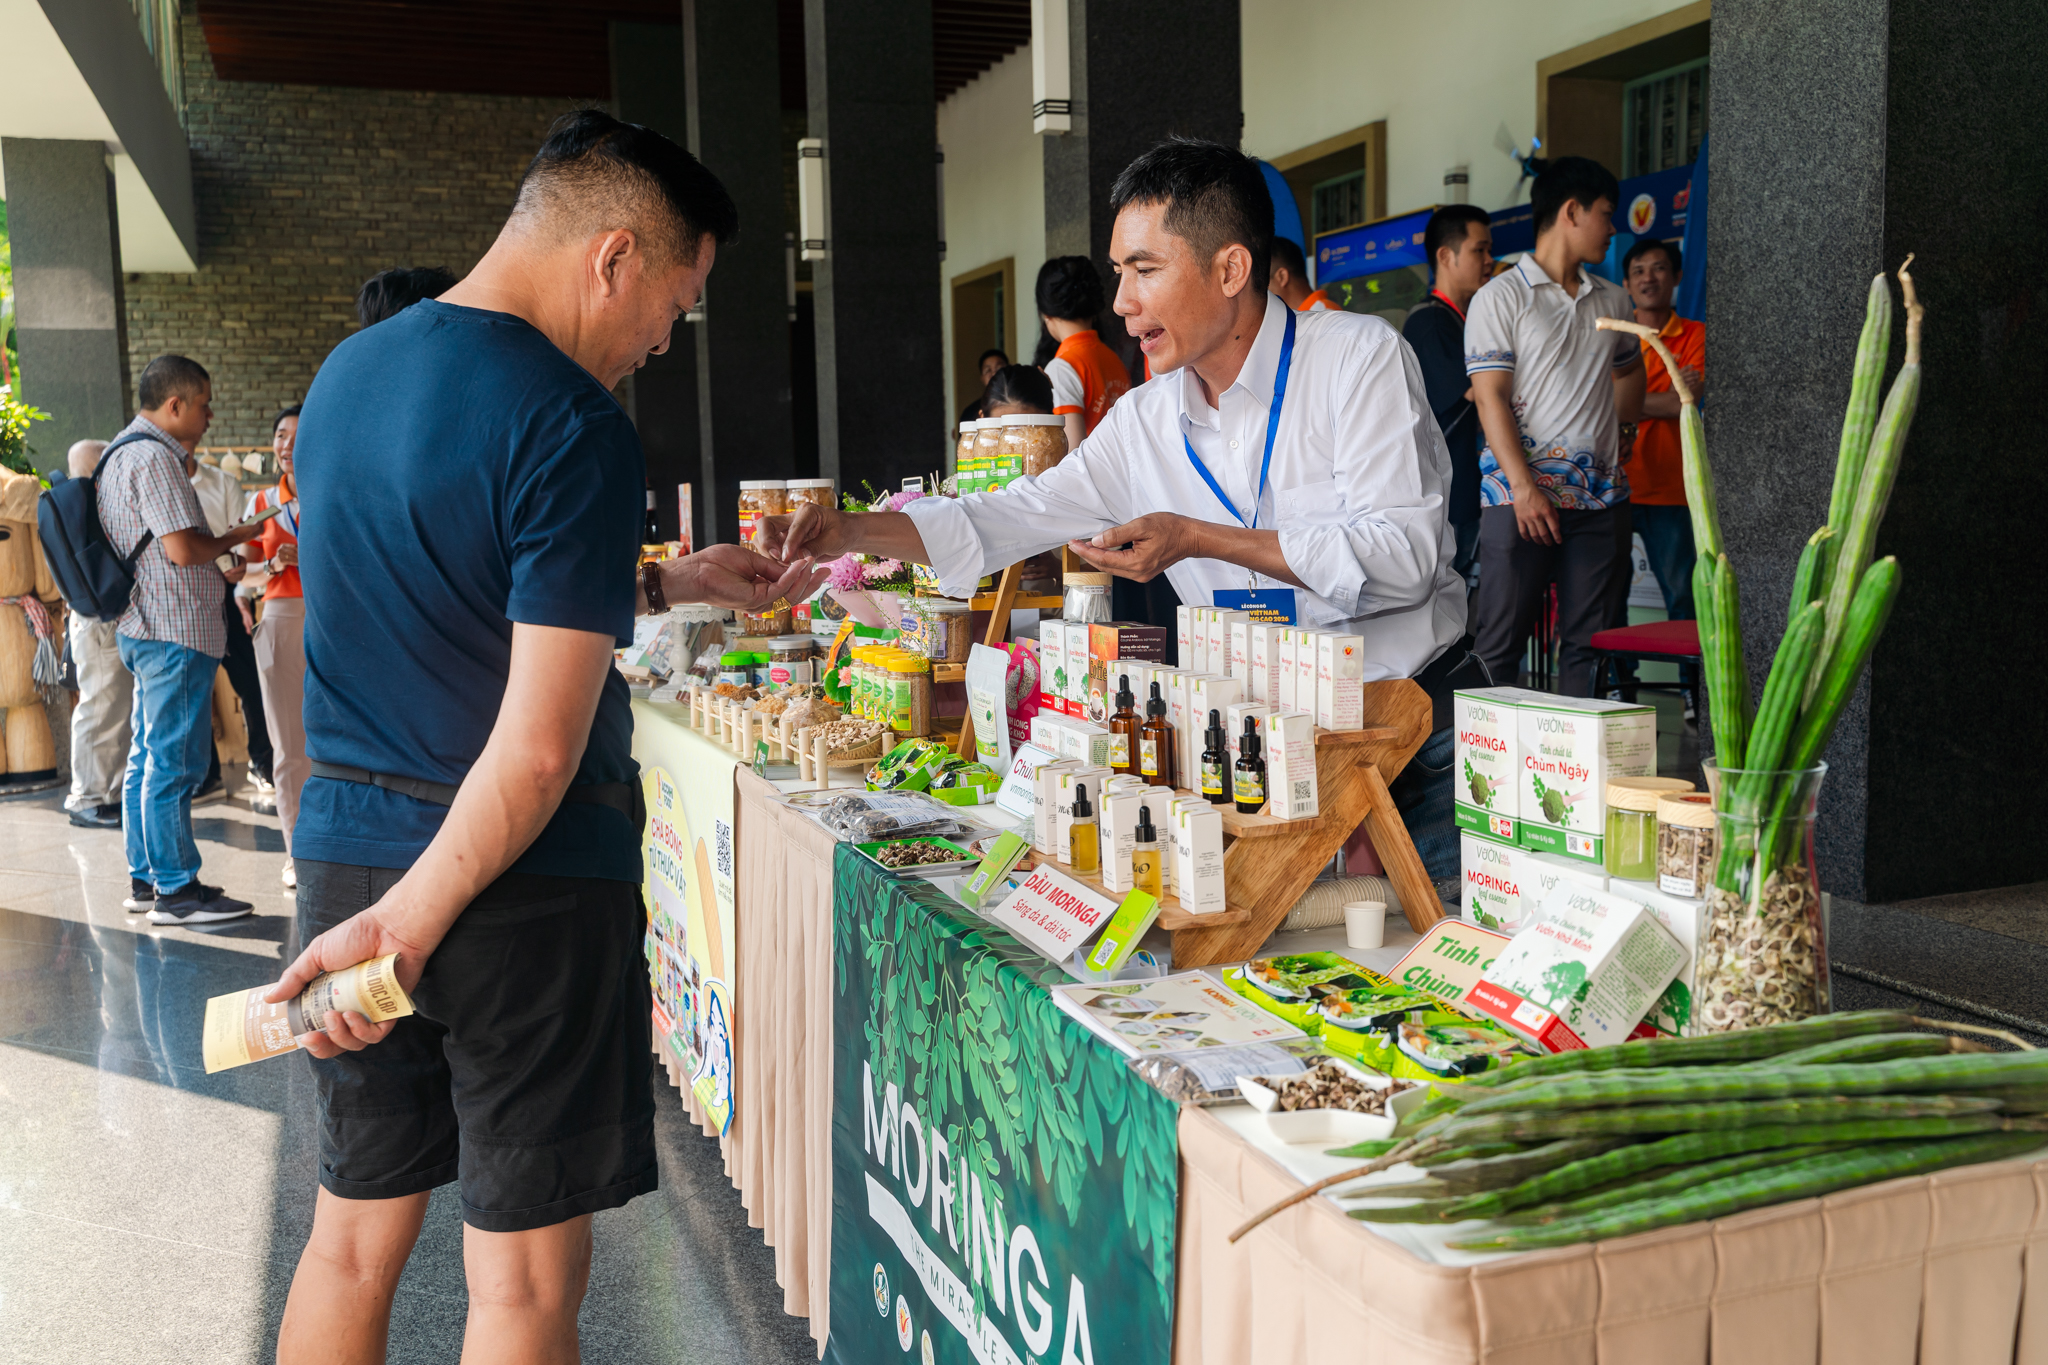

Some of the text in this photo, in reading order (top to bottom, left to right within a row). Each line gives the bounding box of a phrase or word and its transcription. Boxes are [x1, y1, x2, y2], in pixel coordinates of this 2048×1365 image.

[1013, 717, 1029, 730] LONG
[1460, 730, 1507, 753] MORINGA
[1526, 756, 1589, 782] Chùm Ngây
[651, 814, 682, 861] CHÀ BÔNG
[649, 841, 687, 900] TỪ THỰC VẬT
[1468, 869, 1519, 897] MORINGA
[1024, 872, 1101, 927] DẦU MORINGA
[1478, 887, 1508, 905] leaf essence
[1012, 899, 1071, 942] Sáng da & dài tóc
[1432, 935, 1480, 966] Tinh
[1403, 965, 1464, 1000] Chùm
[863, 1059, 1094, 1365] MORINGA
[910, 1234, 997, 1364] THE MIRALE
